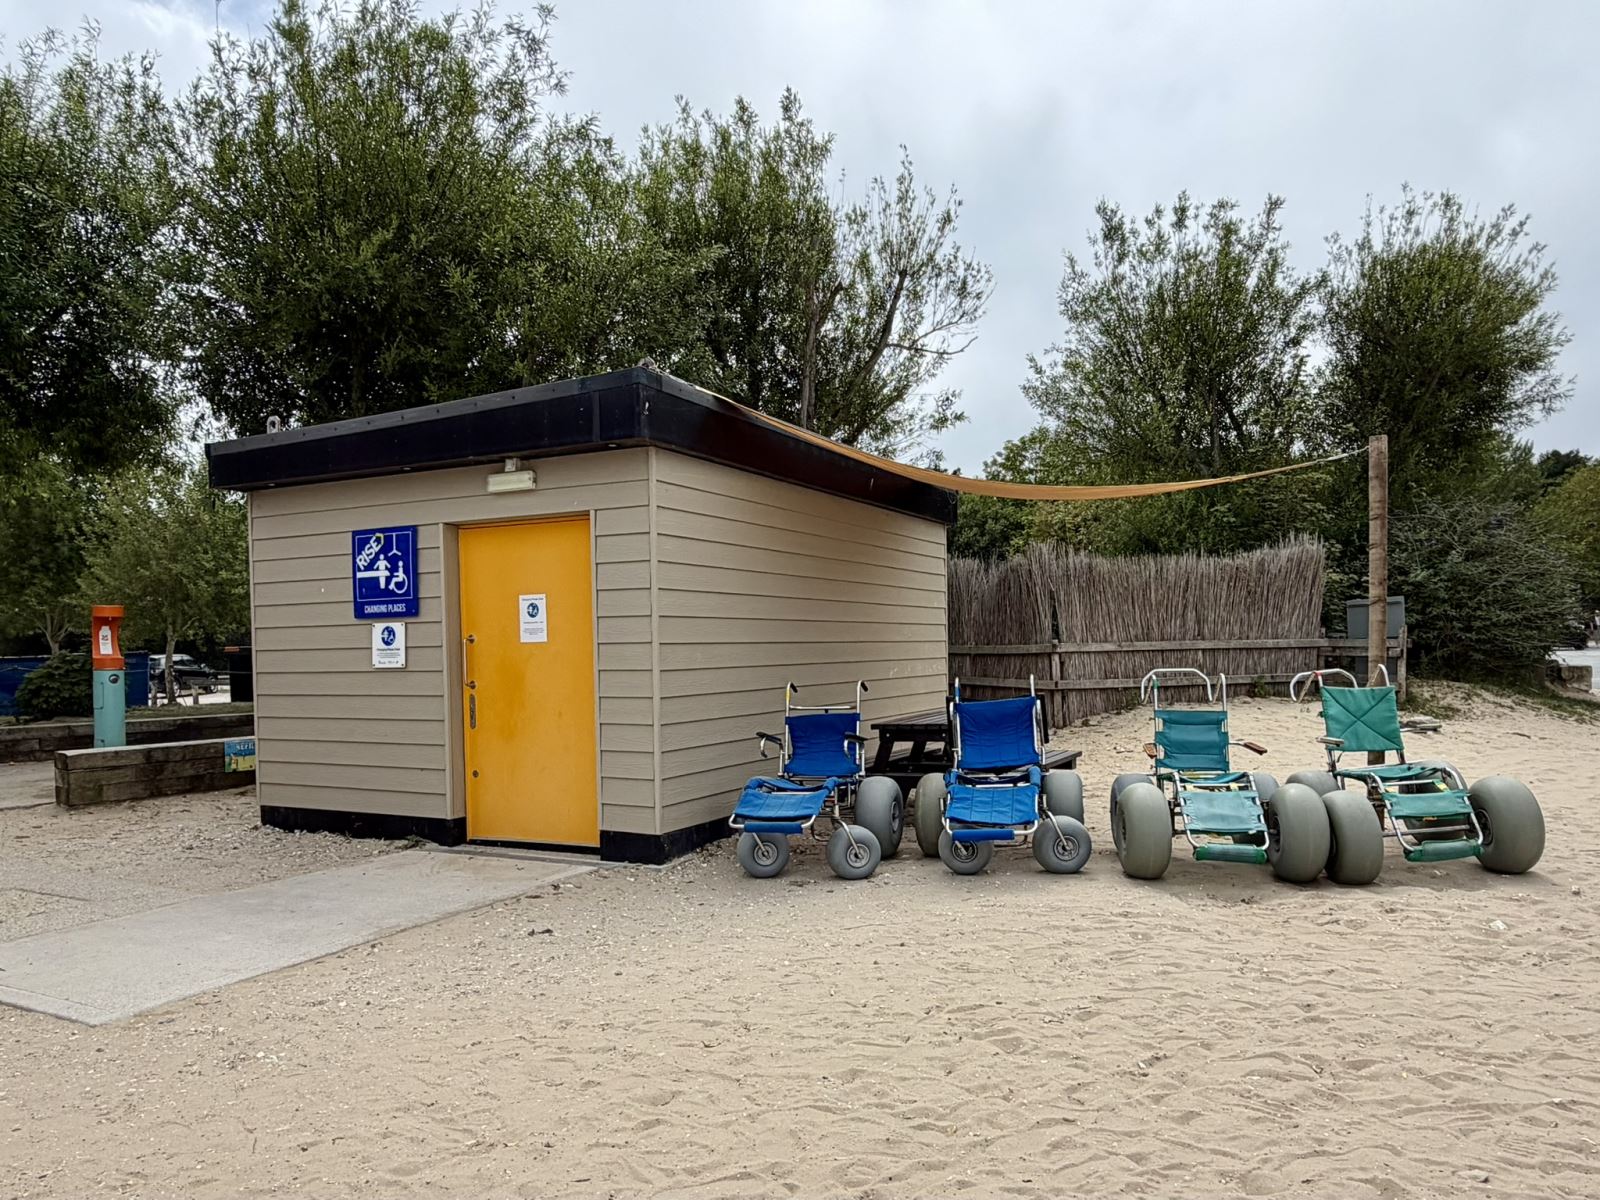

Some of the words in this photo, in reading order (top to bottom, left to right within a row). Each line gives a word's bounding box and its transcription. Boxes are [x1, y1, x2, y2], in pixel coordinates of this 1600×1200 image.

[356, 535, 383, 570] RISE
[364, 605, 387, 614] CHANGING
[388, 603, 406, 613] PLACES
